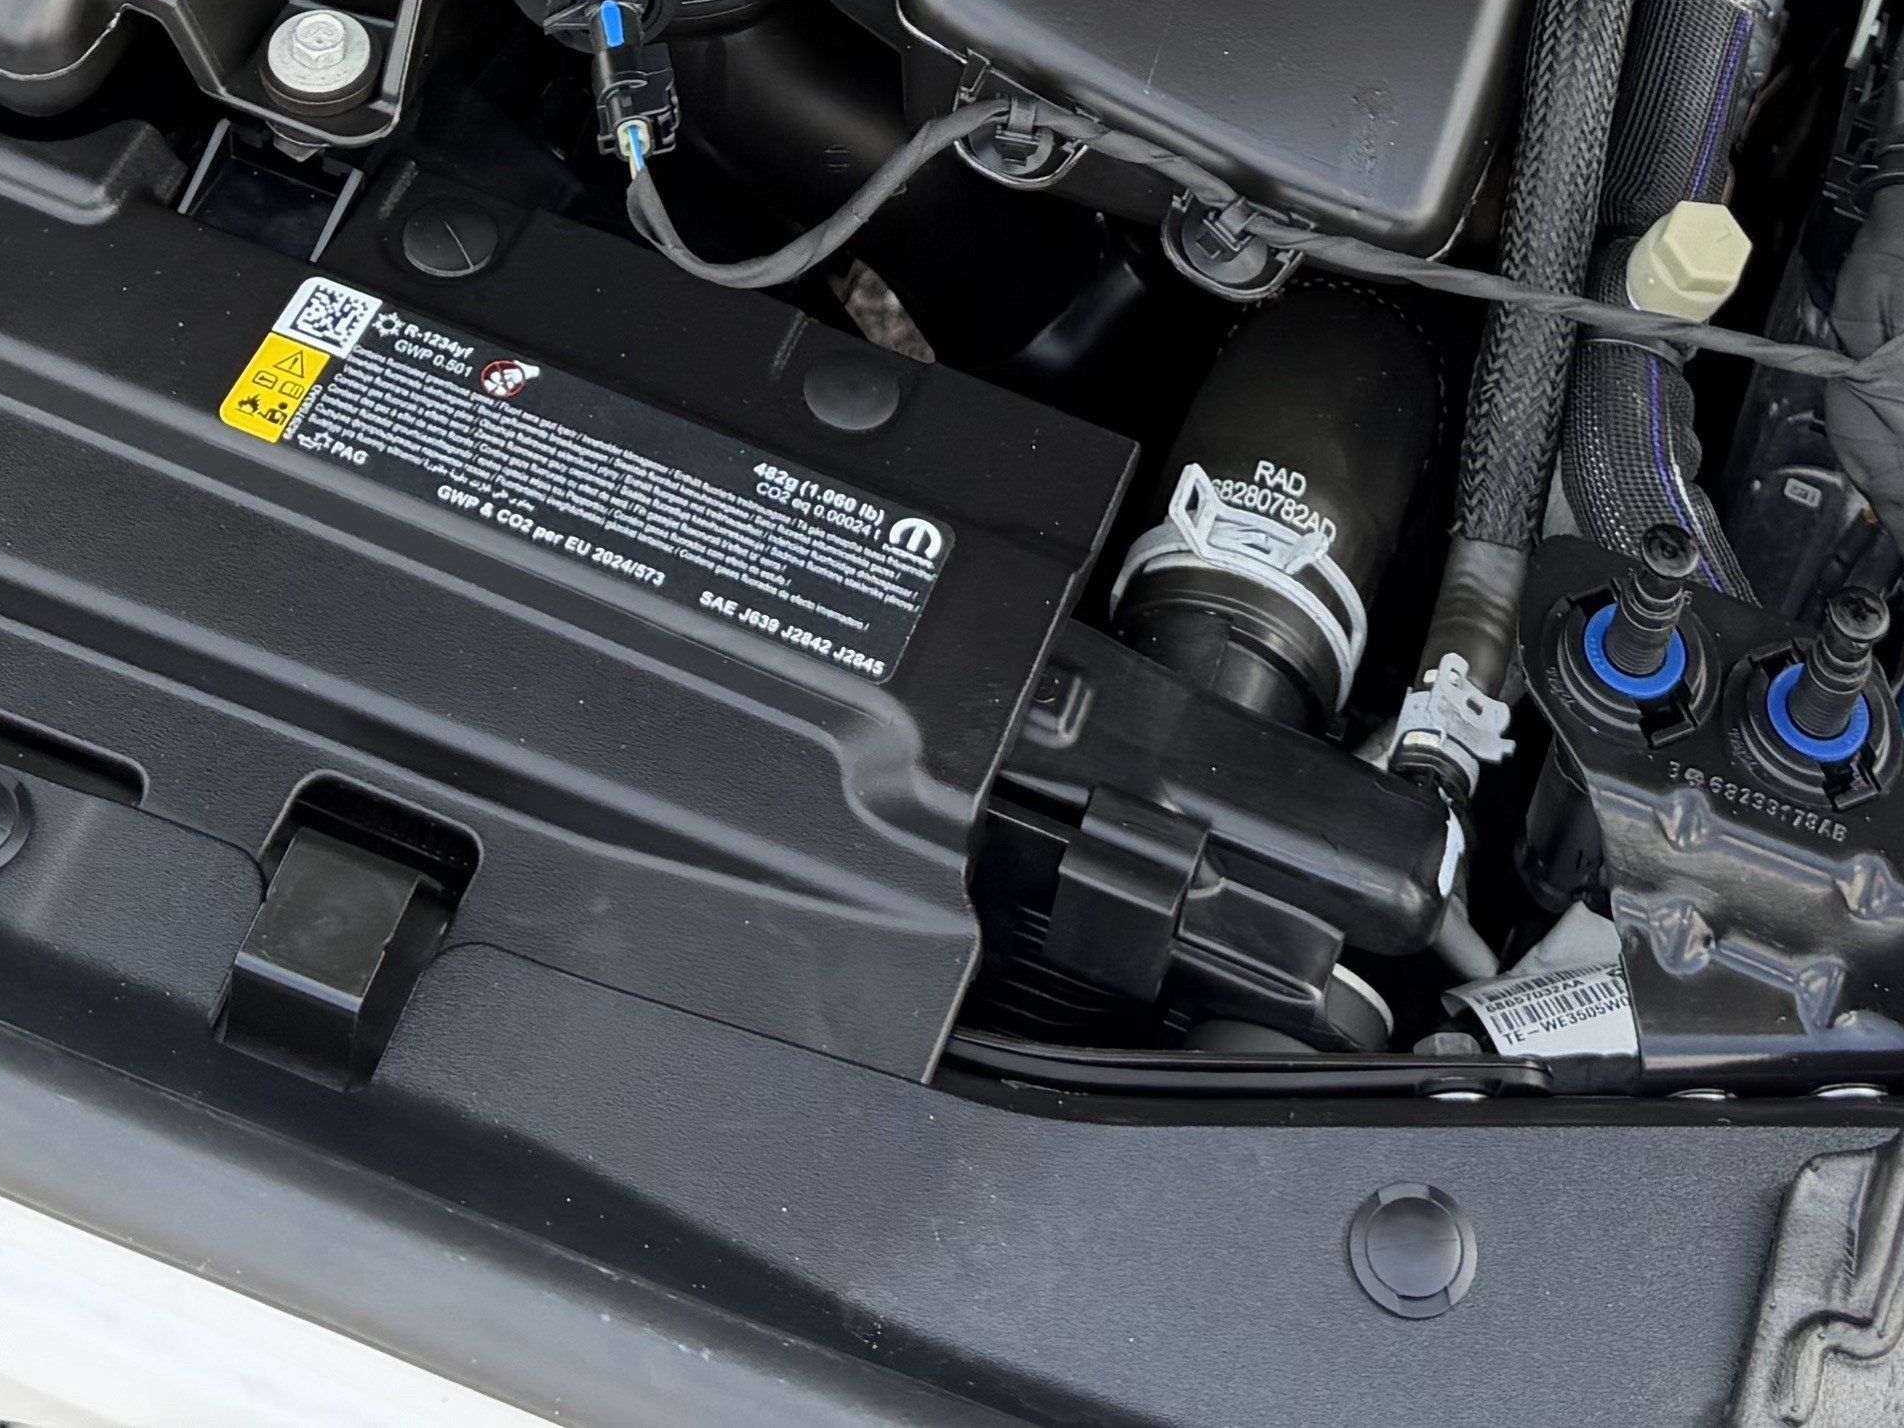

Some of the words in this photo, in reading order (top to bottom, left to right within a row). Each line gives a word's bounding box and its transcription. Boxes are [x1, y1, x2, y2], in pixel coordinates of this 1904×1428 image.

[394, 339, 434, 361] GWP
[432, 352, 473, 378] 0.501
[404, 323, 475, 359] R-1234yf
[330, 441, 370, 465] PAG
[752, 462, 799, 493] 482g
[799, 480, 858, 513] (1.060
[858, 503, 886, 527] lb)
[1253, 460, 1307, 498] RAD
[755, 481, 791, 505] CO2
[791, 496, 812, 515] eq
[813, 504, 872, 538] 0.00024
[873, 527, 881, 541] t
[436, 484, 480, 510] GWP
[479, 502, 495, 519] &
[496, 509, 535, 534] CO2
[532, 526, 565, 546] per
[564, 536, 593, 556] EU
[591, 547, 666, 588] 2024/573
[699, 590, 739, 616] SAE
[738, 607, 781, 633] J639
[780, 625, 833, 656] J2842
[832, 646, 886, 676] J2845
